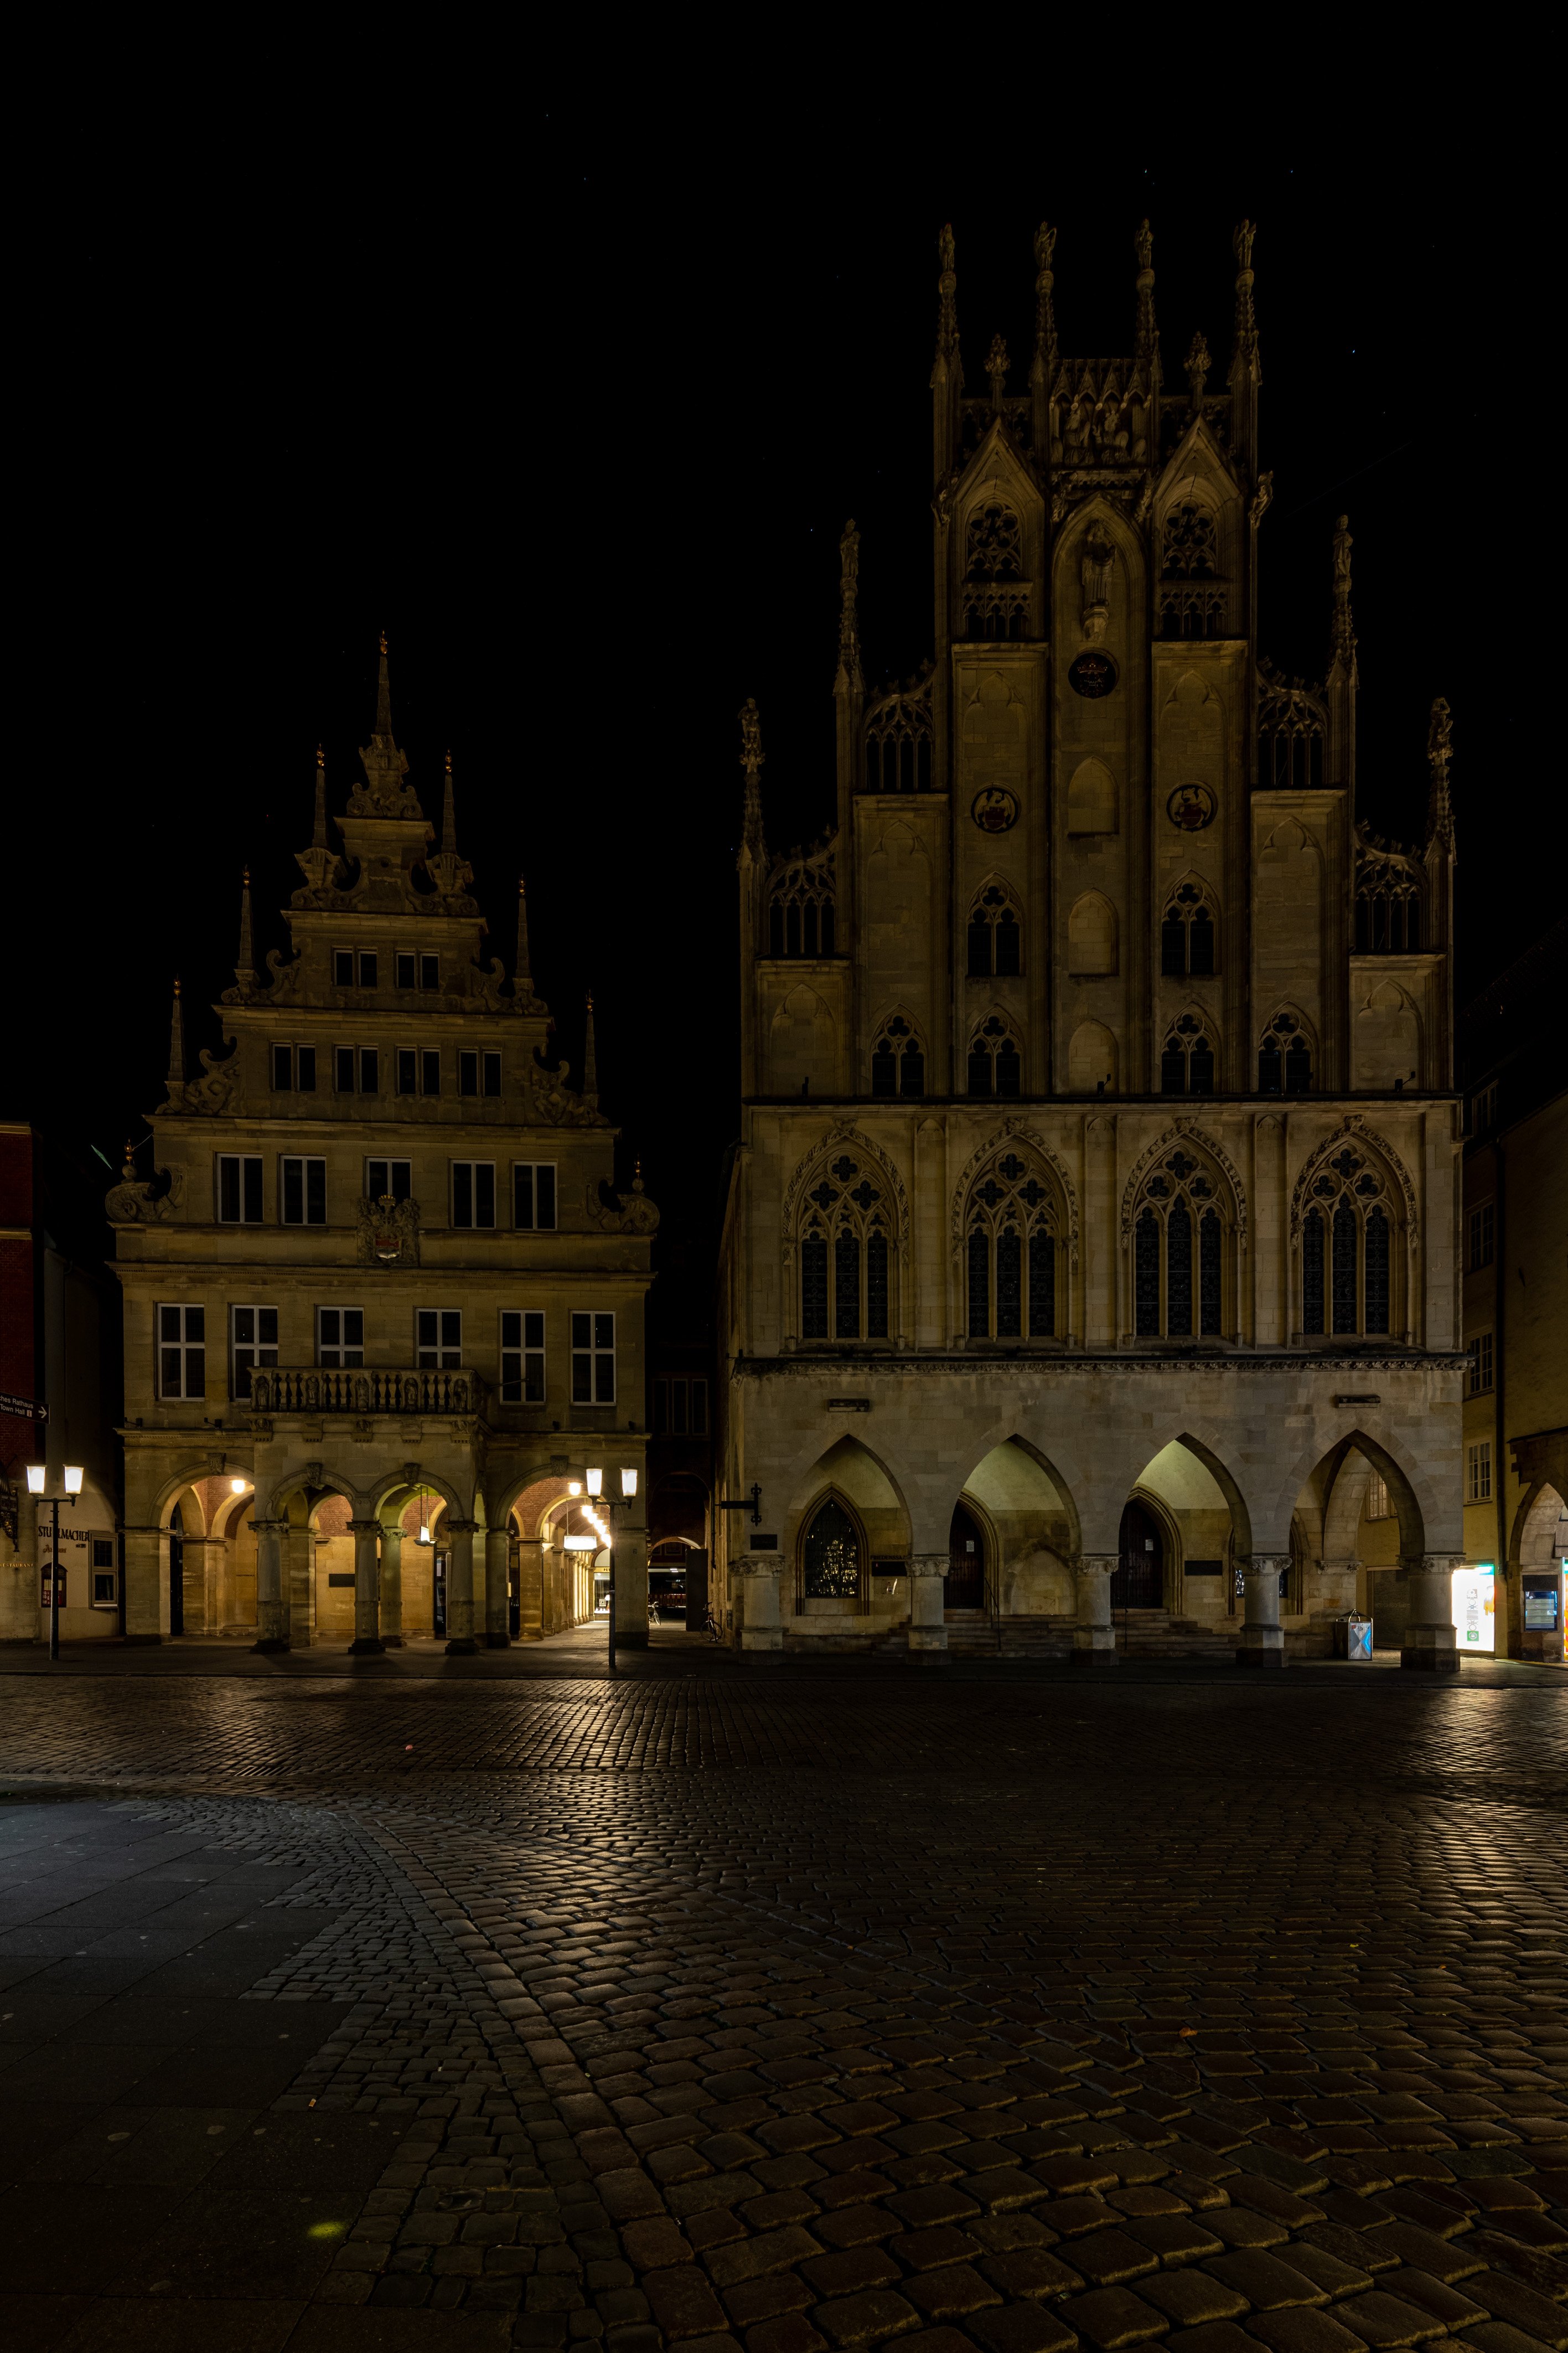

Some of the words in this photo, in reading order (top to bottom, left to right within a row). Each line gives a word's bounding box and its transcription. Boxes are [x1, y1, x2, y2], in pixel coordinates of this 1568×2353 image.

[0, 1403, 14, 1412] Town
[12, 1398, 34, 1409] Rathaus
[38, 1526, 90, 1542] STULMACHER
